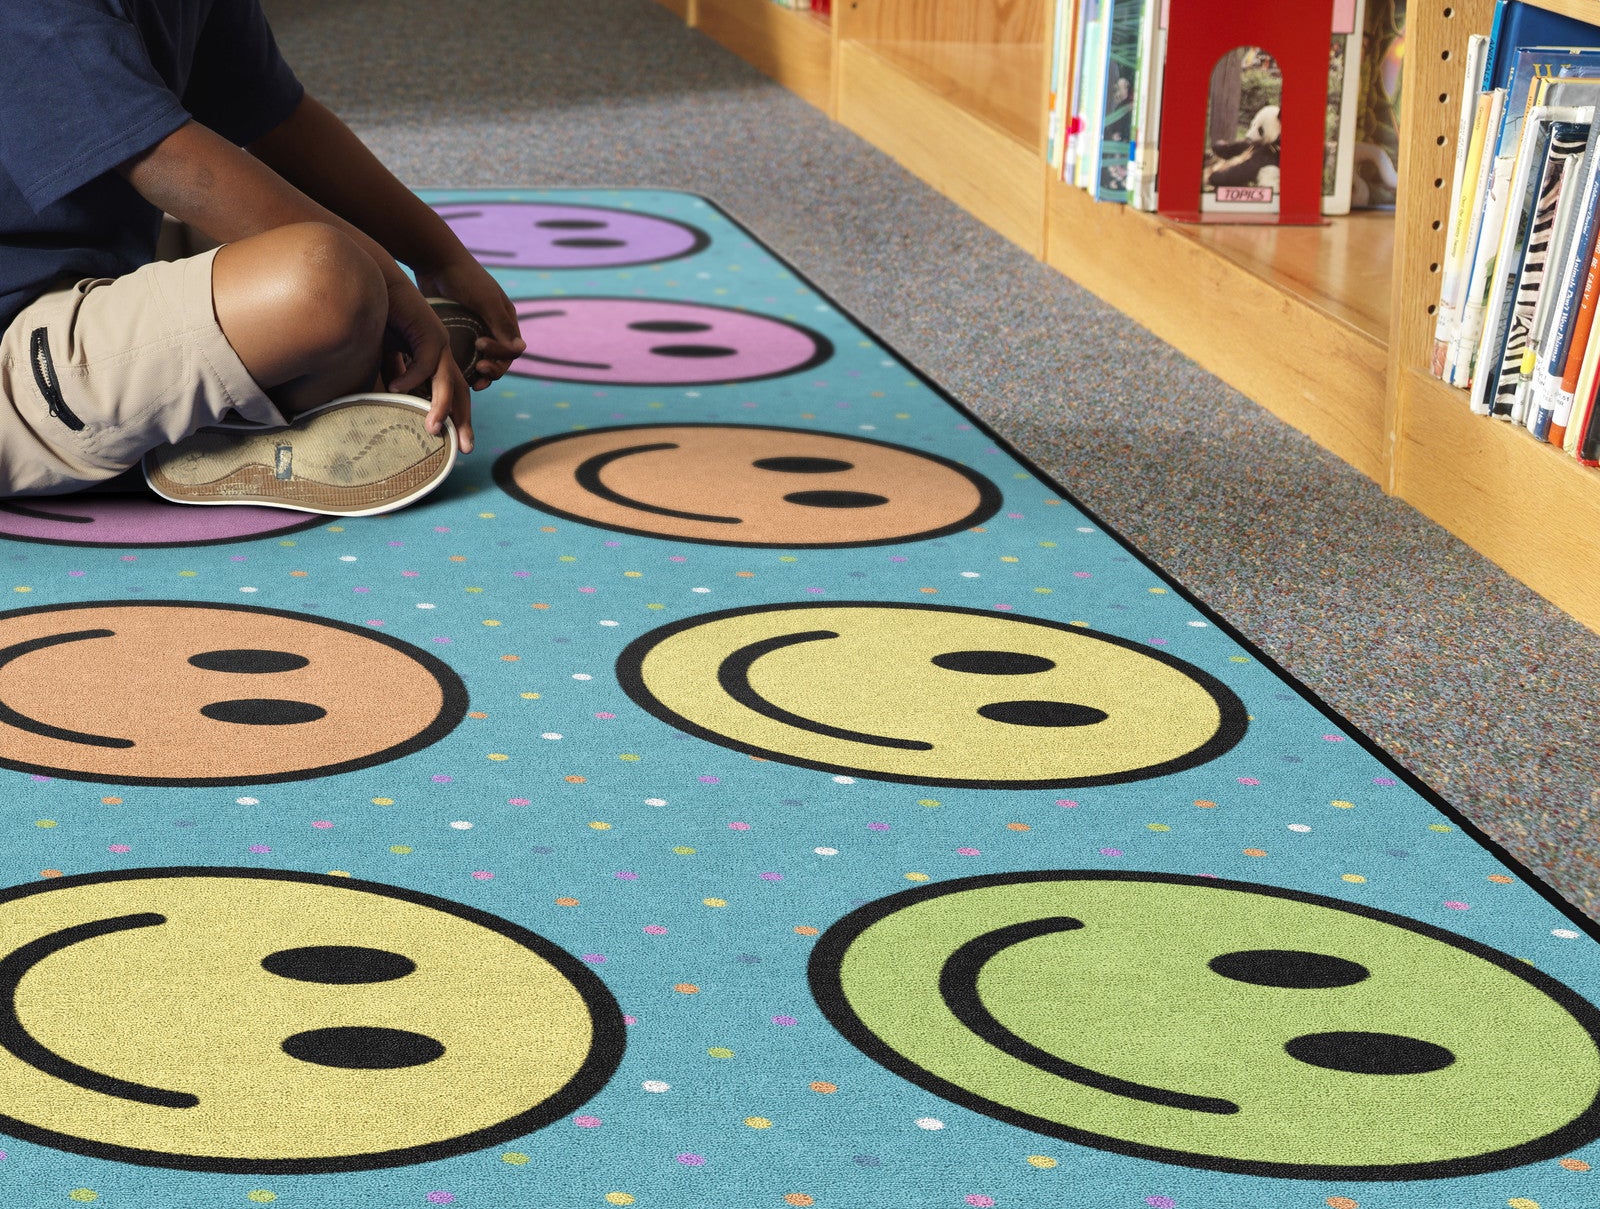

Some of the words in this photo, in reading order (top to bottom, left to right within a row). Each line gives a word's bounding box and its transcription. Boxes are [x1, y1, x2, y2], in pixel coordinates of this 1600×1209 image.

[1484, 38, 1496, 84] ANIMALS
[1225, 189, 1265, 201] TOPICS
[1570, 255, 1582, 288] Animals
[1583, 272, 1595, 300] EARLY
[1551, 331, 1564, 363] Pajamas
